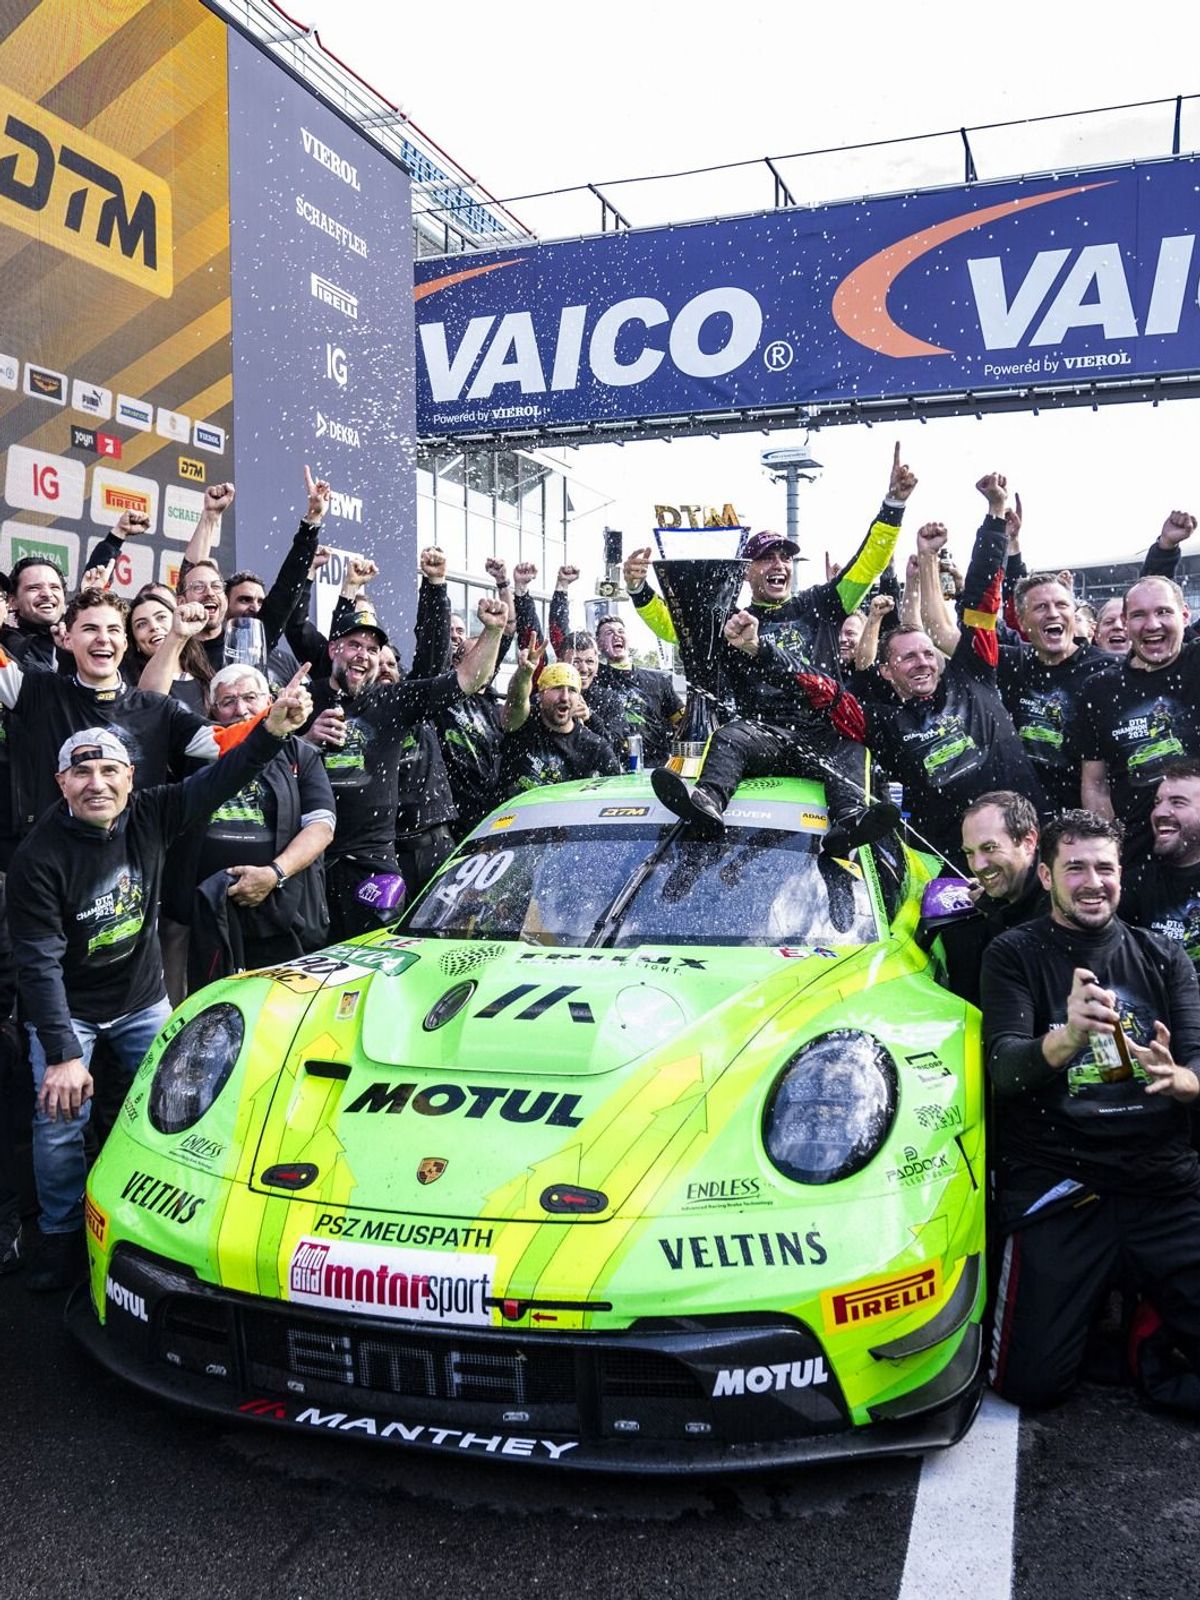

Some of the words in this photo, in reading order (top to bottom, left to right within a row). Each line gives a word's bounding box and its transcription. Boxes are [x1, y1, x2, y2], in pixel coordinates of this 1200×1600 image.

[300, 127, 361, 192] VIEROL
[0, 114, 157, 271] DTM
[295, 195, 368, 259] SCHAEFFLER
[311, 272, 358, 320] PIRELLI
[967, 234, 1200, 350] VAI
[418, 287, 763, 401] VAICO
[326, 344, 348, 385] IG
[984, 361, 1039, 376] Powered
[1043, 360, 1060, 374] by
[1063, 352, 1131, 369] VIEROL
[433, 410, 475, 424] Powered
[477, 410, 489, 422] by
[492, 405, 541, 419] VIEROL
[330, 419, 361, 449] DEKRA
[33, 463, 60, 501] IG
[181, 461, 203, 478] DTM
[105, 488, 147, 513] PIRELLI
[167, 506, 201, 523] SCHAEF
[330, 490, 363, 523] BWT
[655, 503, 741, 528] DTM
[319, 554, 350, 585] ADA
[1111, 724, 1148, 737] CHAMPION
[1127, 730, 1149, 739] 2025
[1128, 717, 1147, 727] DTM
[602, 807, 645, 816] DTM
[802, 812, 827, 821] ADAC
[455, 850, 515, 891] 90
[95, 893, 114, 907] DTM
[343, 1082, 584, 1128] MOTUL
[181, 1134, 227, 1158] ENDLESS
[886, 1153, 948, 1182] PADDOCK
[120, 1170, 206, 1225] VELTINS
[686, 1178, 760, 1199] ENDLESS
[314, 1213, 360, 1237] PSZ
[360, 1219, 493, 1248] MEUSPATH
[293, 1244, 328, 1270] Auto
[658, 1231, 828, 1270] VELTINS
[292, 1266, 320, 1293] Bild
[106, 1273, 149, 1322] MOTUL
[832, 1268, 936, 1325] PIRELLI
[712, 1356, 828, 1397] MOTUL
[295, 1407, 579, 1459] MANTHEY
